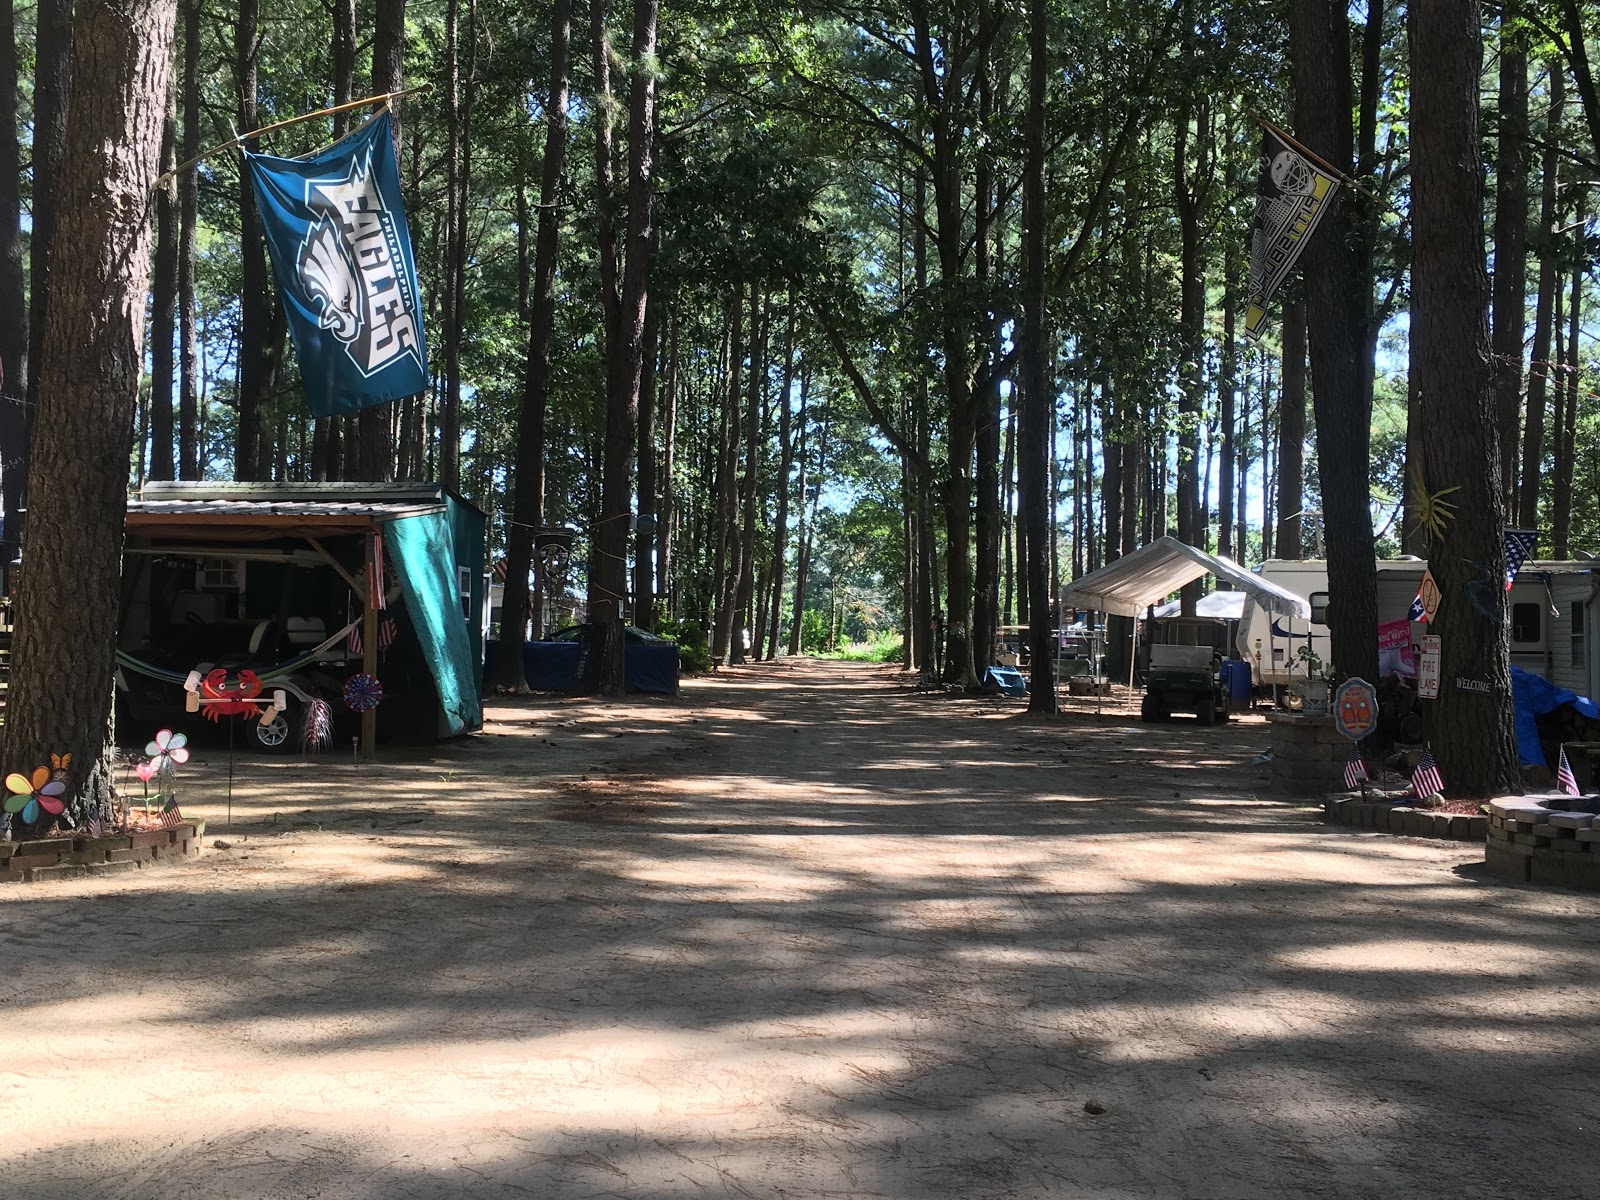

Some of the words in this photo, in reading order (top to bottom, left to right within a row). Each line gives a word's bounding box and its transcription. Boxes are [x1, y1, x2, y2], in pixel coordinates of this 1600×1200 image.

[314, 160, 419, 371] EAGLES
[382, 216, 412, 309] PHILADELPHIA
[1423, 660, 1436, 673] FIRE
[1420, 678, 1437, 690] LANE
[1456, 677, 1491, 693] WELCOME
